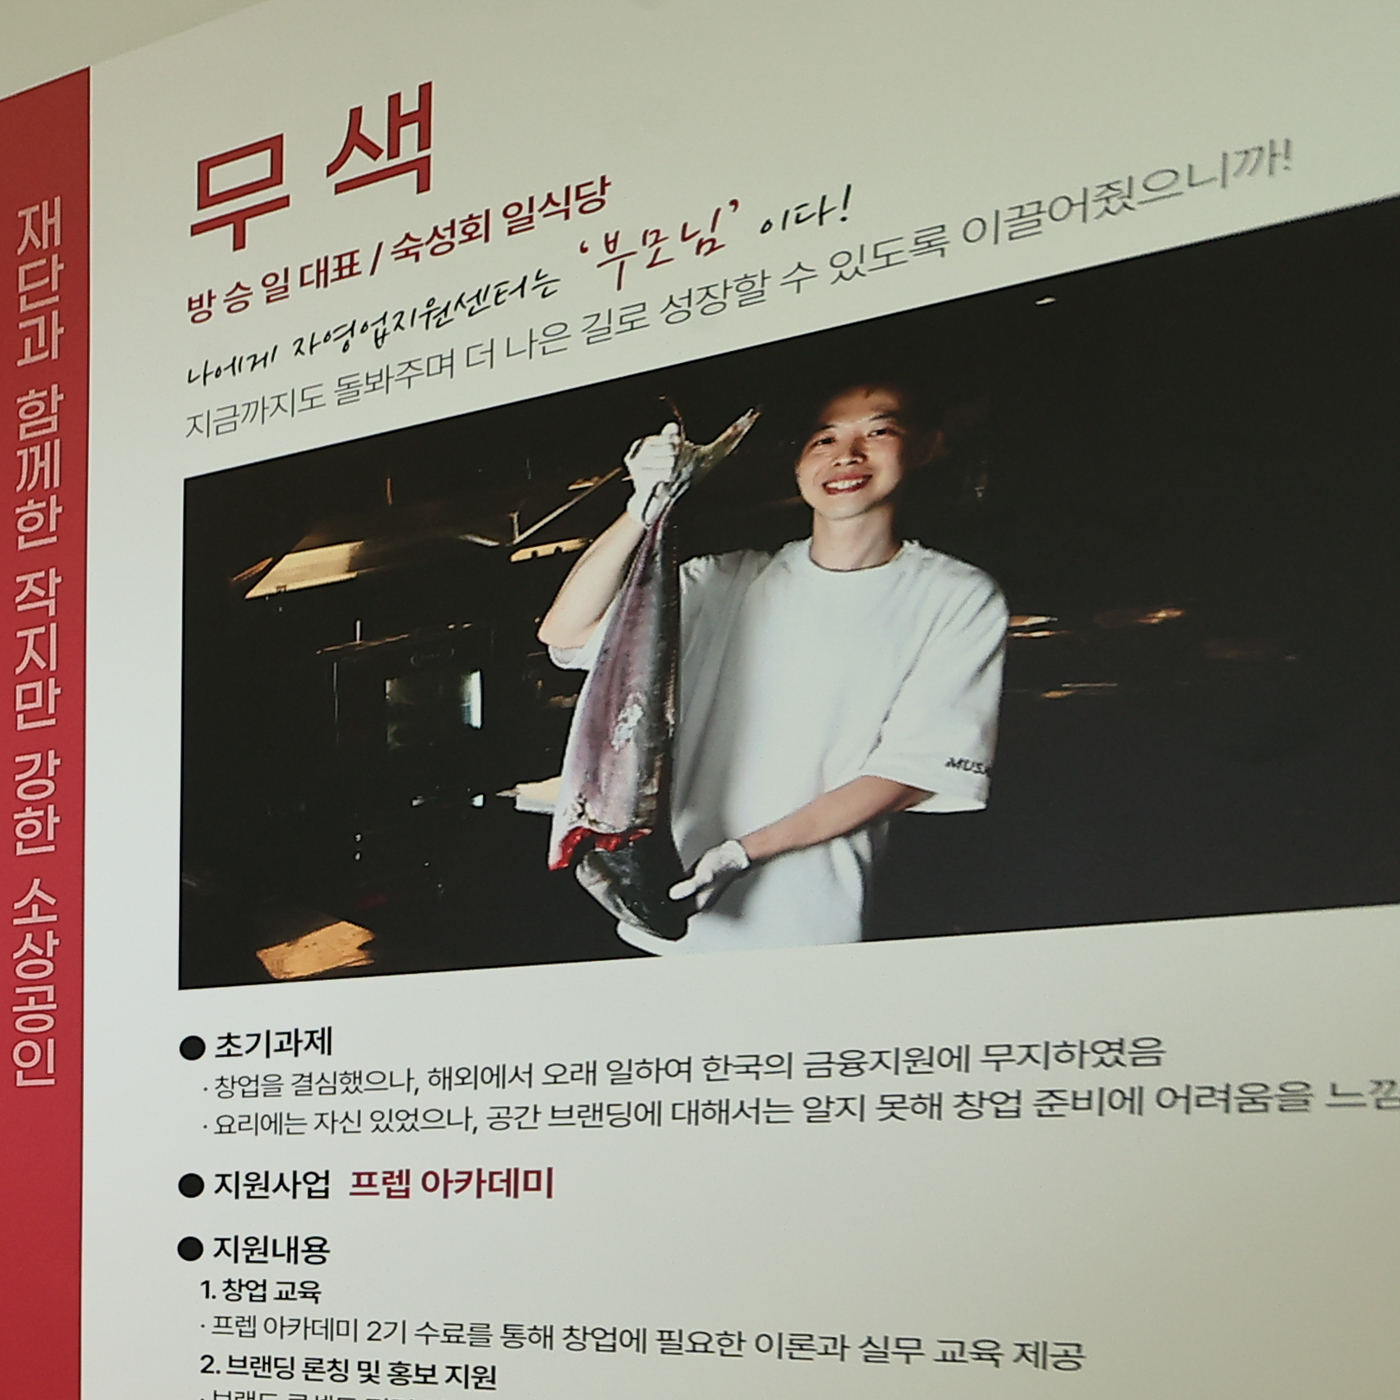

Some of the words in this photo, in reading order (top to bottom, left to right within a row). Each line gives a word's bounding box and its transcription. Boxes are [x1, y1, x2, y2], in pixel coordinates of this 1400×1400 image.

[16, 195, 65, 367] 재단과
[186, 344, 278, 387] 나에게
[292, 268, 562, 359] 자영업지원센터는
[760, 184, 852, 235] 이다!
[300, 249, 362, 289] 대표
[391, 209, 490, 263] 숙성회
[502, 175, 611, 236] 일식당
[186, 383, 326, 438] 지금까지도
[334, 348, 454, 406] 돌봐주며
[466, 338, 494, 369] 더
[506, 322, 571, 360] 나은
[581, 302, 650, 345] 길로
[660, 269, 771, 324] 성장할
[780, 261, 818, 294] 수
[830, 224, 950, 285] 있도록
[963, 139, 1290, 245] 이끌어줬으니까!
[15, 383, 64, 551] 함께한
[13, 567, 62, 731] 작지만
[13, 749, 61, 856] 강한
[12, 877, 60, 1088] 소상공인
[215, 1026, 332, 1058] 초기과제
[215, 1074, 284, 1099] 창업을
[291, 1068, 419, 1096] 결심했으나,
[428, 1063, 532, 1091] 해외에서
[542, 1060, 596, 1086] 오래
[606, 1056, 691, 1085] 일하여
[702, 1052, 792, 1082] 한국의
[803, 1045, 970, 1078] 금융지원에
[980, 1037, 1166, 1072] 무지하였음
[214, 1170, 329, 1199] 지원사업
[349, 1169, 410, 1199] 프렙
[422, 1167, 553, 1199] 아카데미
[201, 1280, 216, 1299] 1.
[222, 1278, 266, 1302] 창업
[274, 1281, 321, 1304] 교육
[213, 1235, 330, 1265] 지원내용
[201, 1355, 220, 1374] 2.
[226, 1355, 294, 1380] 브랜딩
[302, 1358, 348, 1383] 론칭
[358, 1360, 380, 1384] 및
[387, 1361, 438, 1386] 홍보
[445, 1364, 496, 1390] 지원
